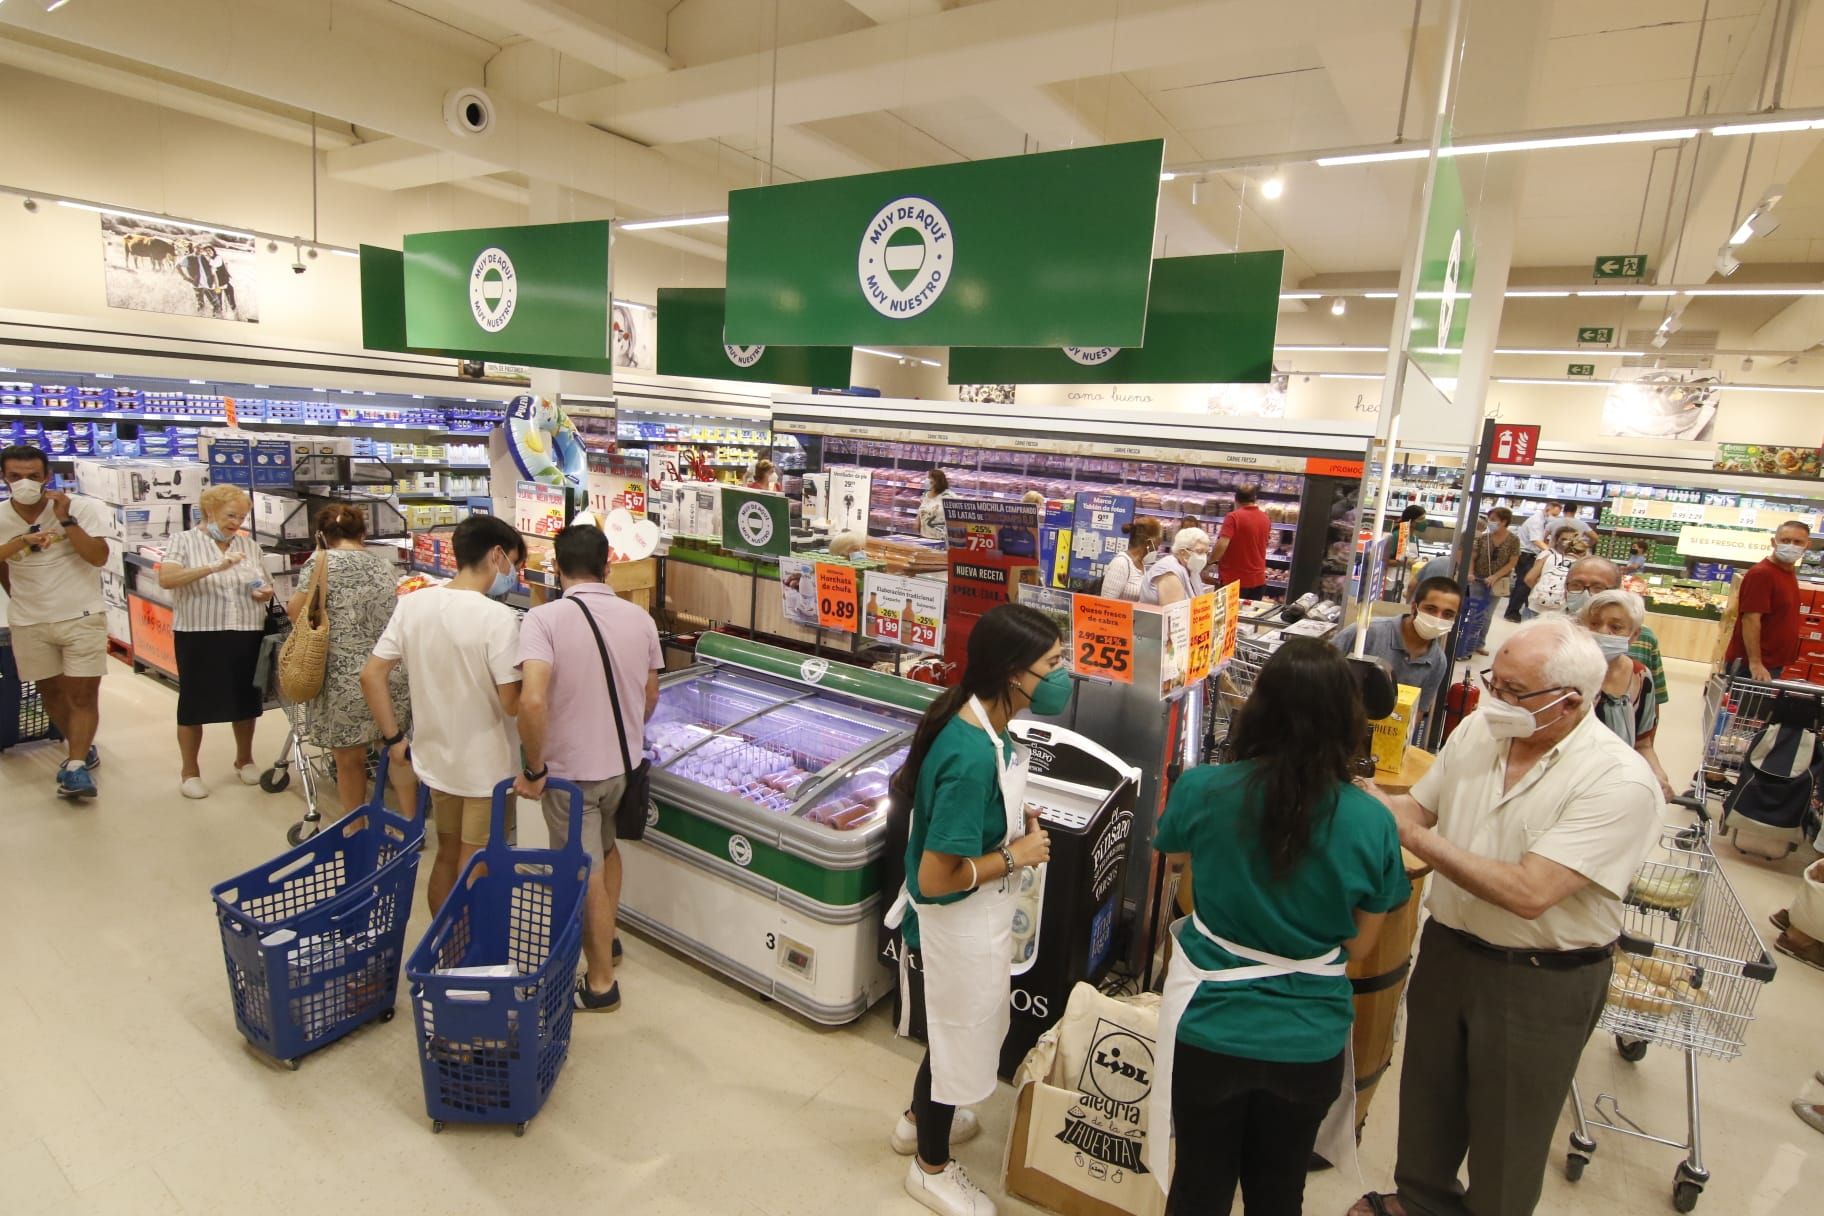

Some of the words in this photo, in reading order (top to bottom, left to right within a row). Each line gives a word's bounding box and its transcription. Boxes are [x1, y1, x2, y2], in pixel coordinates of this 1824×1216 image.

[870, 211, 894, 245] MUY
[897, 206, 915, 221] DE
[915, 208, 948, 243] AQUÍ
[474, 257, 487, 280] MUY
[487, 254, 497, 264] DE
[866, 274, 889, 305] MUY
[889, 270, 942, 312] NUESTRO
[474, 300, 487, 322] MUY
[486, 299, 512, 328] NUESTRO
[1111, 384, 1153, 402] bueno
[1226, 455, 1241, 463] CARNE
[1241, 456, 1257, 464] FRESCA
[976, 501, 1005, 513] MOCHILA
[1748, 542, 1759, 550] ES
[820, 574, 852, 585] Horchata
[956, 565, 978, 578] NUEVA
[979, 568, 1004, 582] RECETA
[831, 584, 852, 594] chufa
[876, 586, 905, 597] Elaboración
[906, 592, 935, 602] tradicional
[821, 598, 855, 619] 0.89
[881, 608, 898, 618] -26%
[1079, 604, 1103, 616] Queso
[1103, 608, 1128, 619] fresco
[917, 616, 934, 626] -25%
[1087, 614, 1097, 622] de
[1097, 616, 1120, 627] cabra
[1078, 630, 1096, 642] 2.99
[1079, 642, 1131, 673] 2.55
[765, 932, 776, 950] 3
[1094, 1047, 1150, 1086] LIDL
[1091, 1116, 1103, 1127] de
[1109, 1122, 1121, 1135] la
[1072, 1124, 1133, 1166] HUERTA
